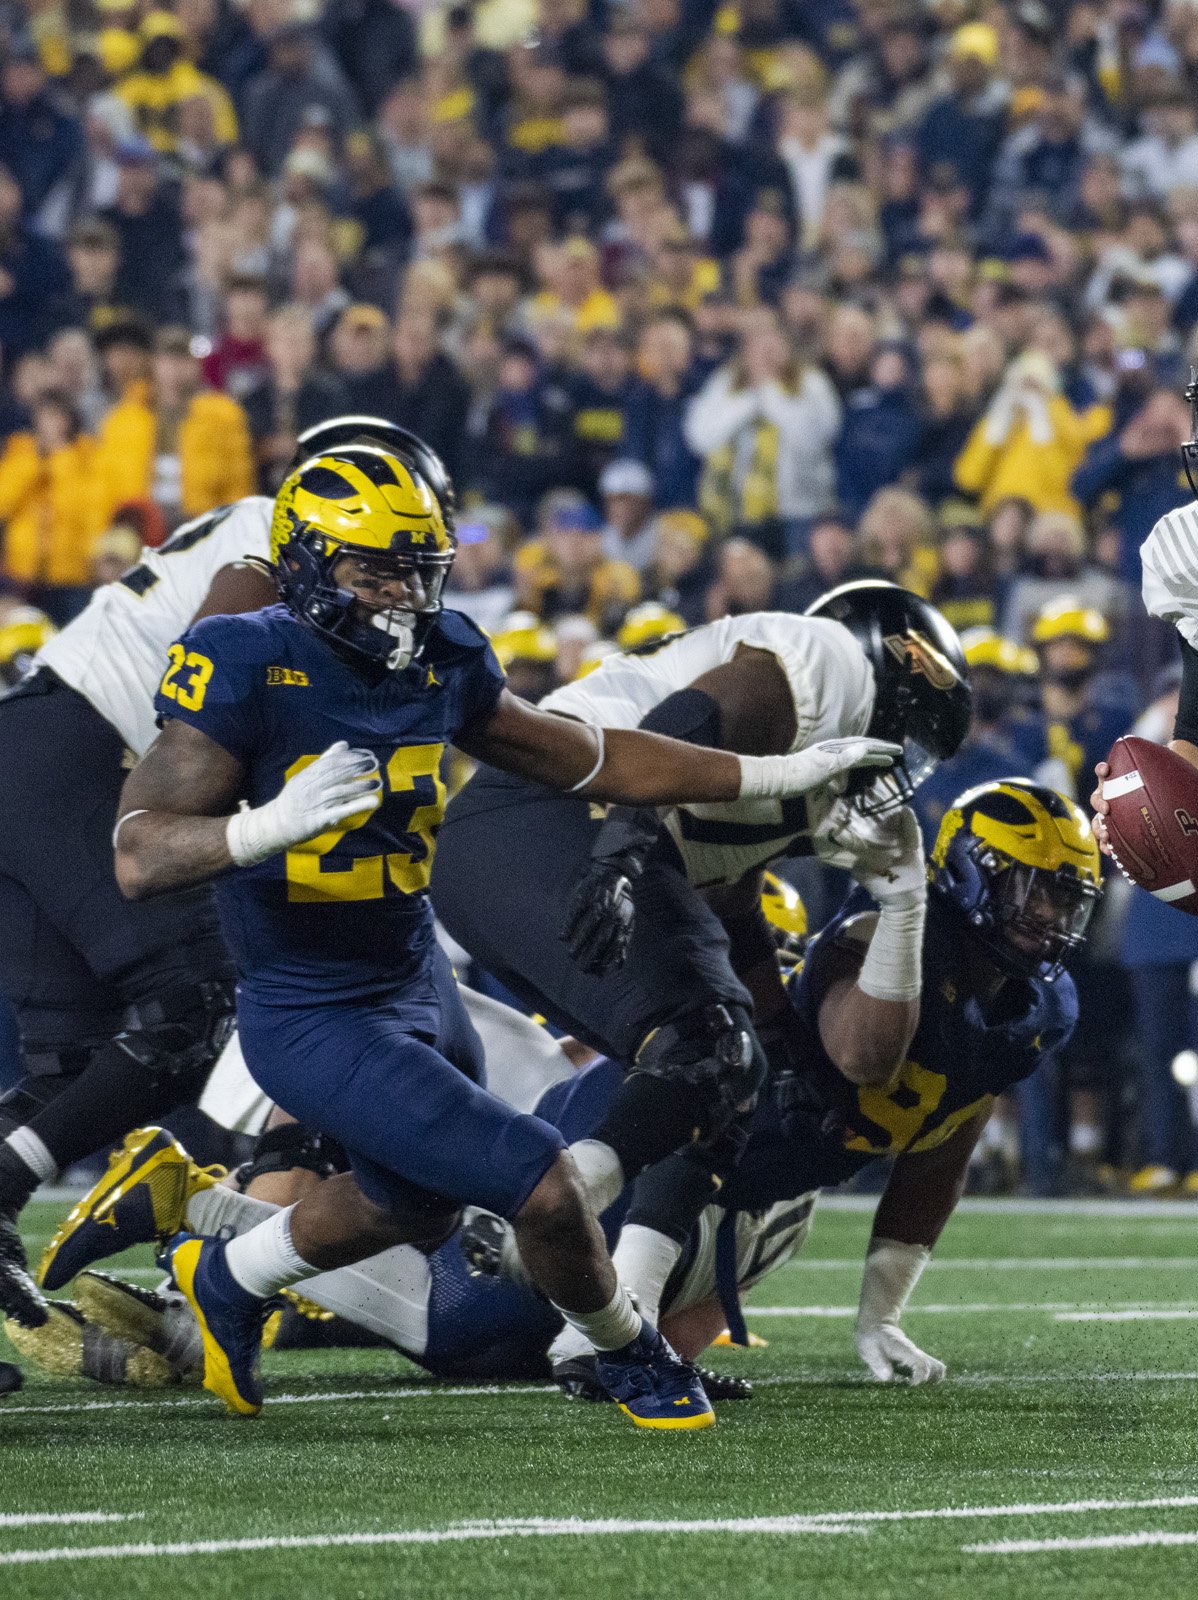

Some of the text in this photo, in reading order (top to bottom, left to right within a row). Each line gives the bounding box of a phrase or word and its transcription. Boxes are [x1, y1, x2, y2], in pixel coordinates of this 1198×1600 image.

[410, 531, 425, 544] M
[160, 643, 214, 712] 23
[284, 742, 447, 903] 23
